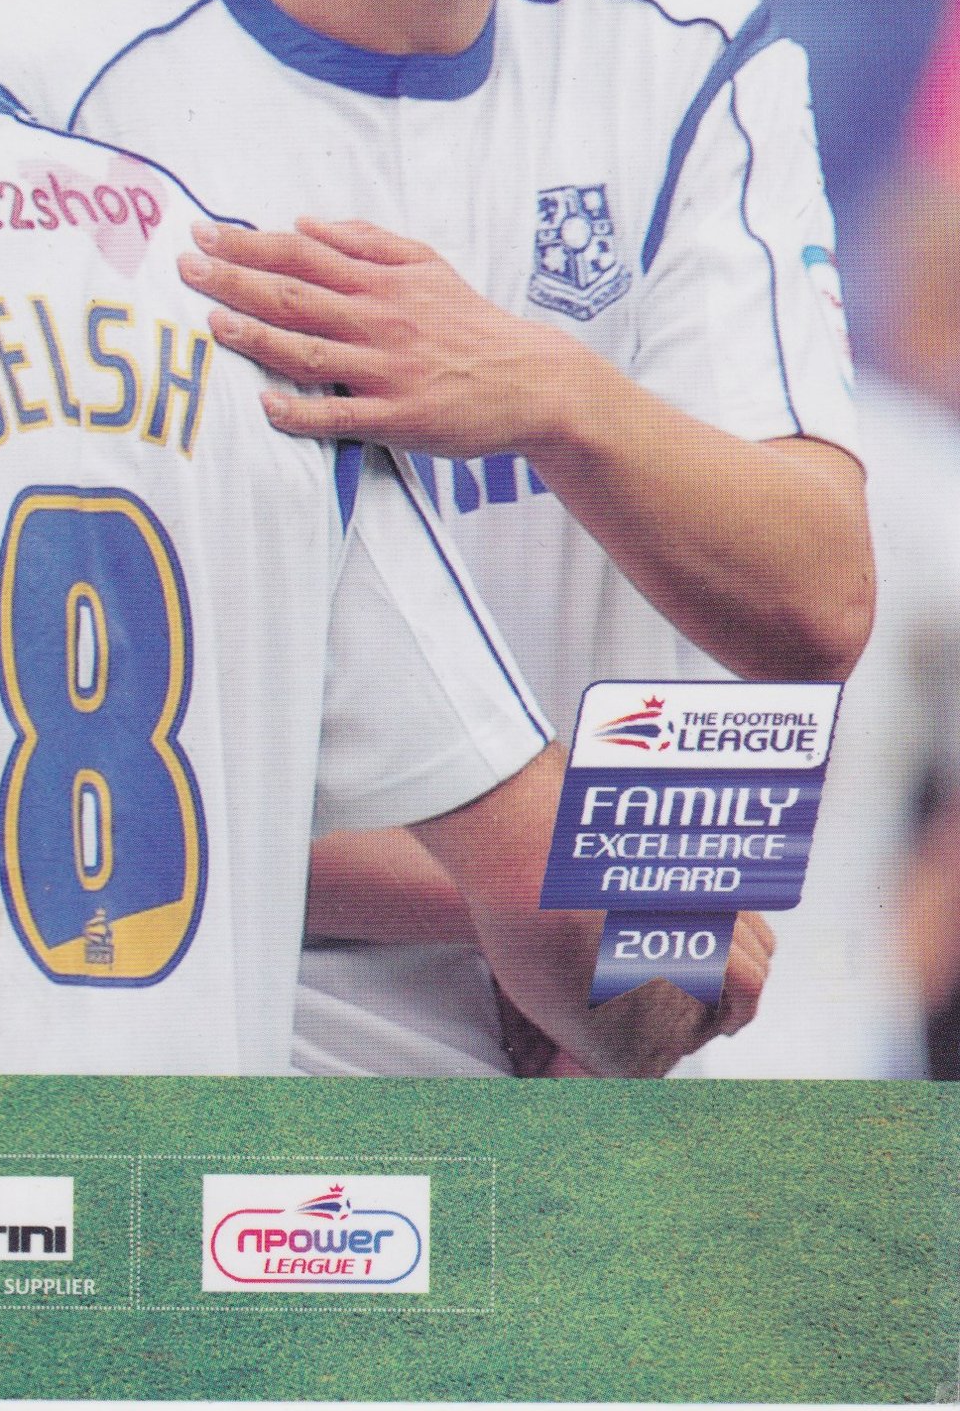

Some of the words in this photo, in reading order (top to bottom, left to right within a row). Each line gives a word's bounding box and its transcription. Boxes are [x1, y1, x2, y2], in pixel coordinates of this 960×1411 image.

[682, 711, 720, 726] THE
[722, 711, 819, 727] FOOTBALL
[677, 729, 818, 752] LEAGUE
[579, 786, 801, 827] FAMILY
[572, 833, 787, 860] EXCELLENCE
[601, 866, 742, 892] AWARD
[614, 930, 717, 960] 2010
[263, 1258, 357, 1275] LEAGUE
[364, 1258, 374, 1276] 1
[4, 1278, 97, 1296] SUPPLIER
